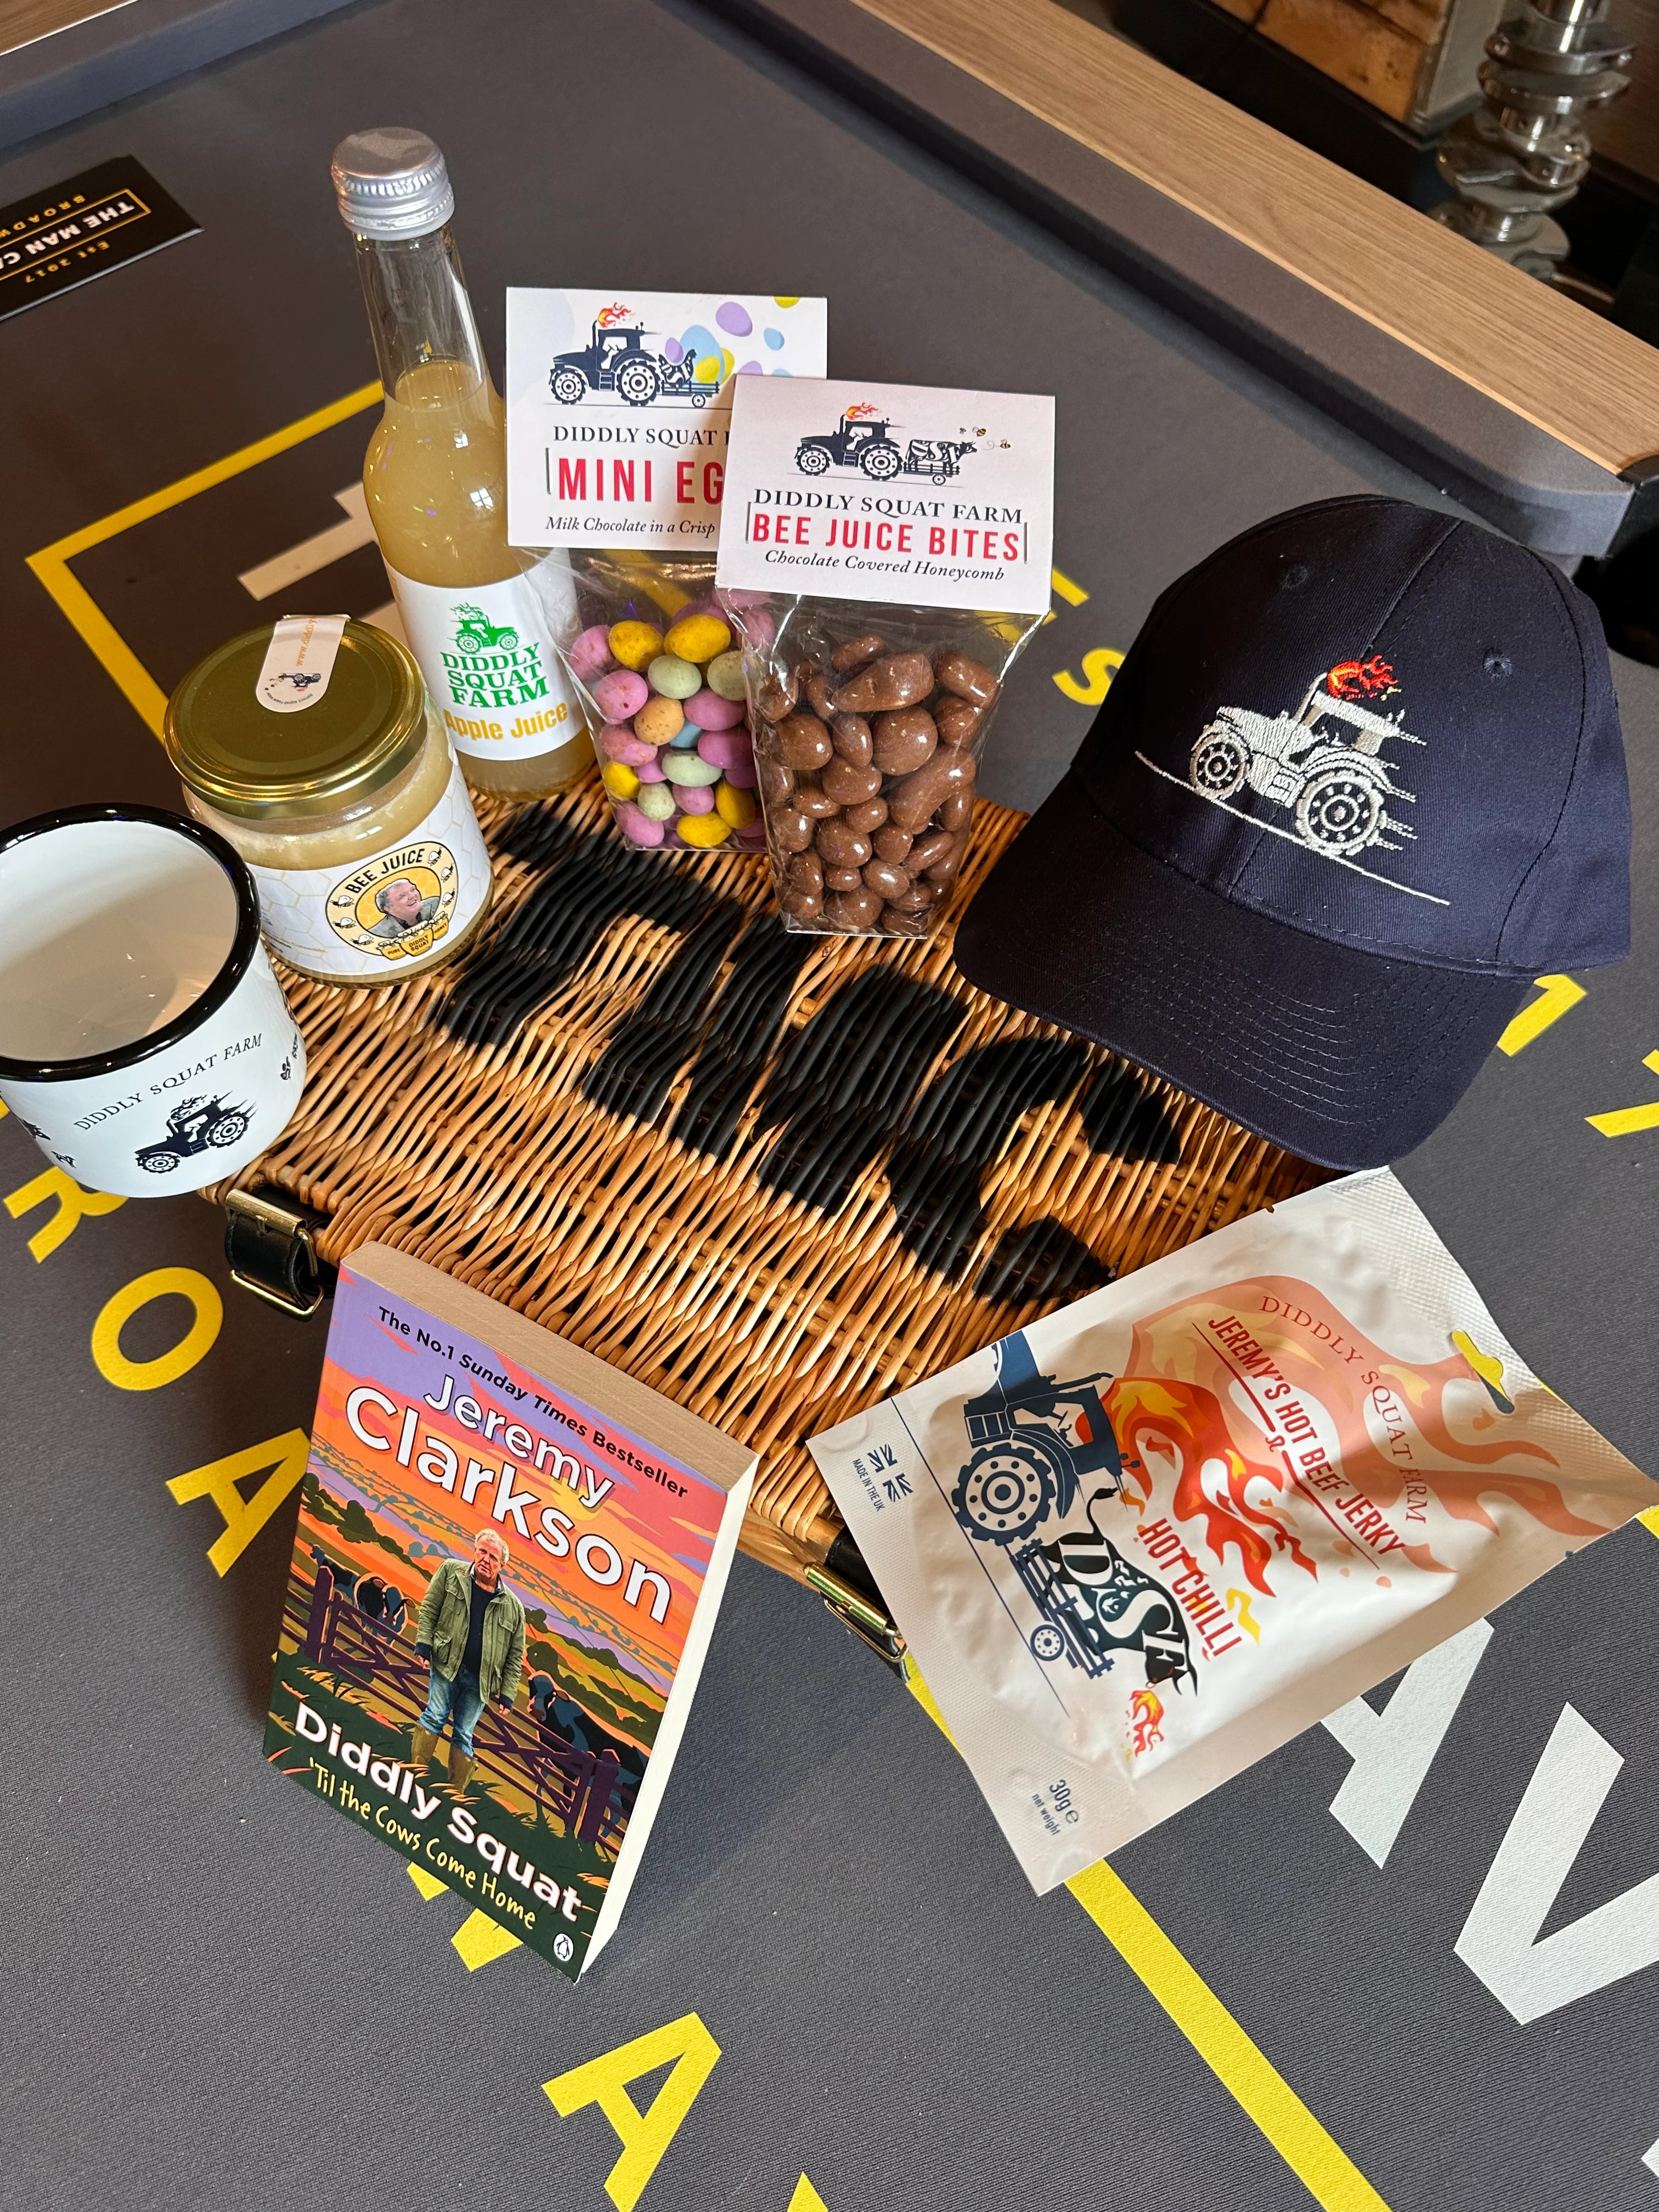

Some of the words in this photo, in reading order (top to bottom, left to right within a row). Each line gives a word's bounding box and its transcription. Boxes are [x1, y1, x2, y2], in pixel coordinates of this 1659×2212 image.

[83, 201, 135, 228] THE
[25, 224, 81, 255] MAN
[77, 240, 110, 258] Est
[25, 258, 71, 283] 2017
[554, 426, 640, 443] DIDDLY
[646, 428, 718, 447] SQUAT
[558, 458, 652, 503] MINI
[754, 489, 854, 511] DIDDLY
[861, 497, 945, 518] SQUAT
[952, 504, 1022, 523] FARM
[546, 516, 579, 531] Milk
[584, 517, 646, 532] Chocolate
[651, 520, 664, 532] in
[667, 523, 675, 533] a
[679, 520, 715, 538] Crisp
[753, 514, 811, 545] BEE
[826, 520, 913, 552] JUICE
[929, 527, 1019, 561] BITES
[765, 550, 839, 568] Chocolate
[845, 556, 910, 574] Covered
[913, 561, 1004, 583] Honeycomb
[440, 642, 540, 671] DIDDLY
[448, 661, 542, 690] SQUAT
[449, 676, 550, 708] FARM
[443, 709, 504, 741] Apple
[511, 702, 568, 738] Juice
[345, 870, 377, 894] BEE
[381, 848, 425, 874] JUICE
[409, 934, 428, 948] DIDDLY
[410, 939, 430, 952] SQUAT
[74, 1092, 143, 1130] DIDDLY
[150, 1054, 217, 1095] SQUAT
[223, 1033, 262, 1062] FARM
[379, 1306, 411, 1335] The
[416, 1328, 454, 1360] No.1
[459, 1354, 528, 1402] Sunday
[534, 1395, 588, 1436] Times
[592, 1430, 688, 1500] Bestseller
[1259, 1295, 1364, 1365] DIDDLY
[1361, 1370, 1412, 1460] SQUAT
[1399, 1467, 1429, 1524] FARM
[424, 1374, 614, 1509] Jeremy
[1209, 1315, 1290, 1401] JEREMY'S
[1276, 1397, 1317, 1449] HOT
[1299, 1445, 1351, 1499] BEEF
[1334, 1492, 1406, 1556] JERKY
[853, 1458, 868, 1479] MADE
[862, 1477, 872, 1487] IN
[867, 1486, 879, 1501] THE
[873, 1499, 885, 1511] UK
[346, 1386, 672, 1625] Clarkson
[1138, 1517, 1188, 1571] HOT
[1171, 1569, 1242, 1657] CHILLI
[295, 1702, 441, 1820] Diddly
[447, 1807, 583, 1922] Squat
[1032, 1793, 1045, 1808] net
[1040, 1808, 1060, 1835] weight
[1049, 1779, 1071, 1812] 30g
[309, 1757, 334, 1798] 'Til
[340, 1786, 371, 1820] the
[376, 1810, 421, 1850] Cows
[426, 1837, 476, 1888] Come
[481, 1873, 536, 1930] Home
